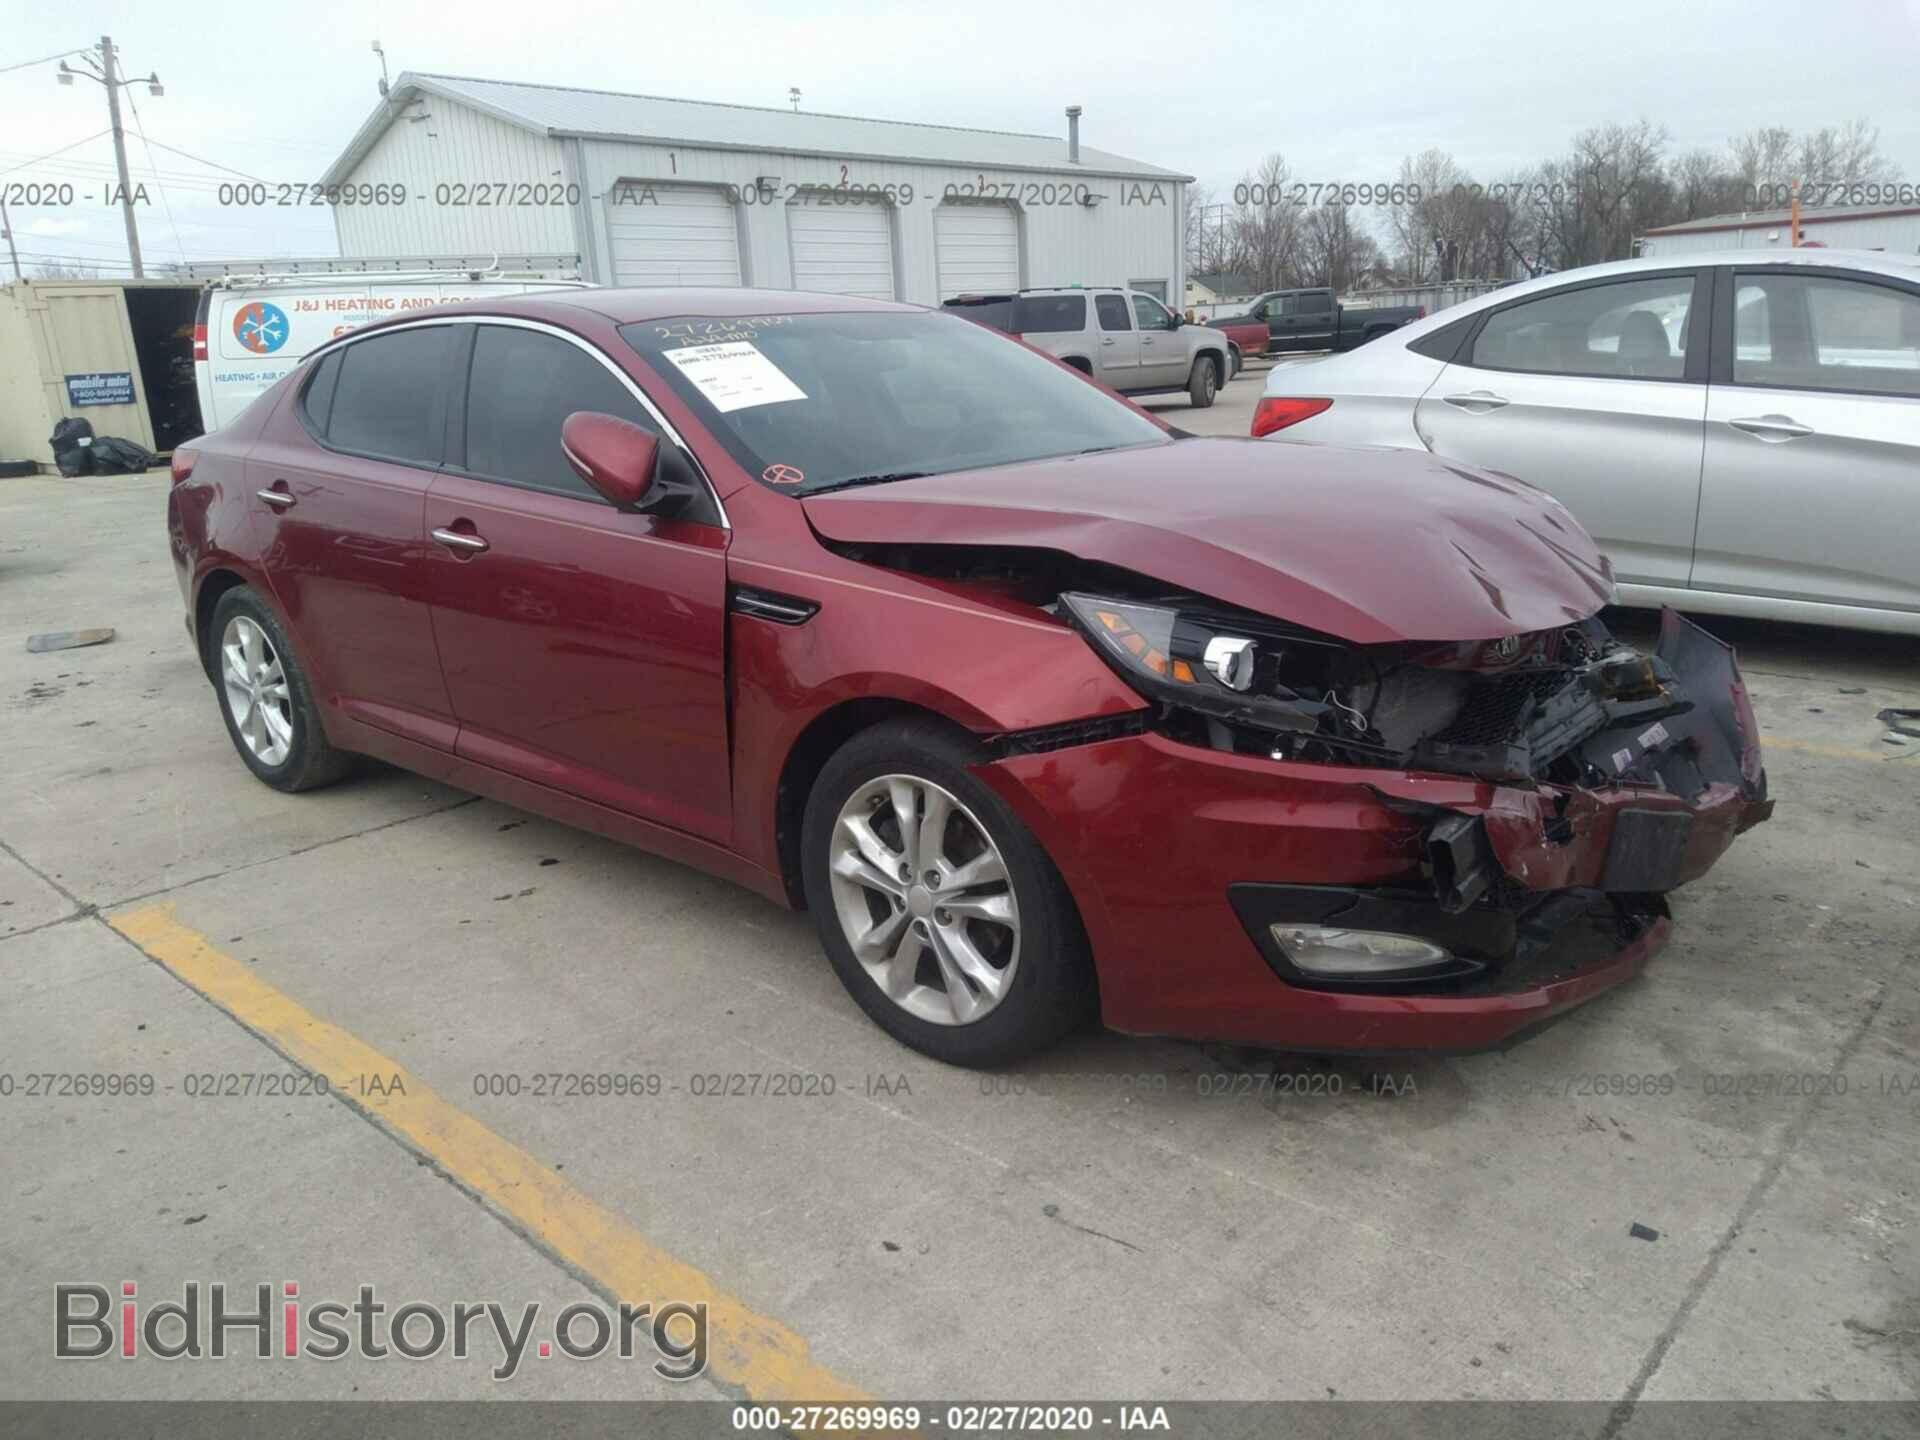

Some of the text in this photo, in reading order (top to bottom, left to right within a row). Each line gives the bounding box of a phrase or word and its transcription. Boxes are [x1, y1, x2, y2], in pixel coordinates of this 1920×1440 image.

[669, 151, 677, 175] 1
[840, 164, 850, 185] 2
[294, 300, 319, 312] J&J
[325, 298, 395, 311] HEATING
[400, 297, 434, 310] AND
[215, 372, 255, 383] HEATING
